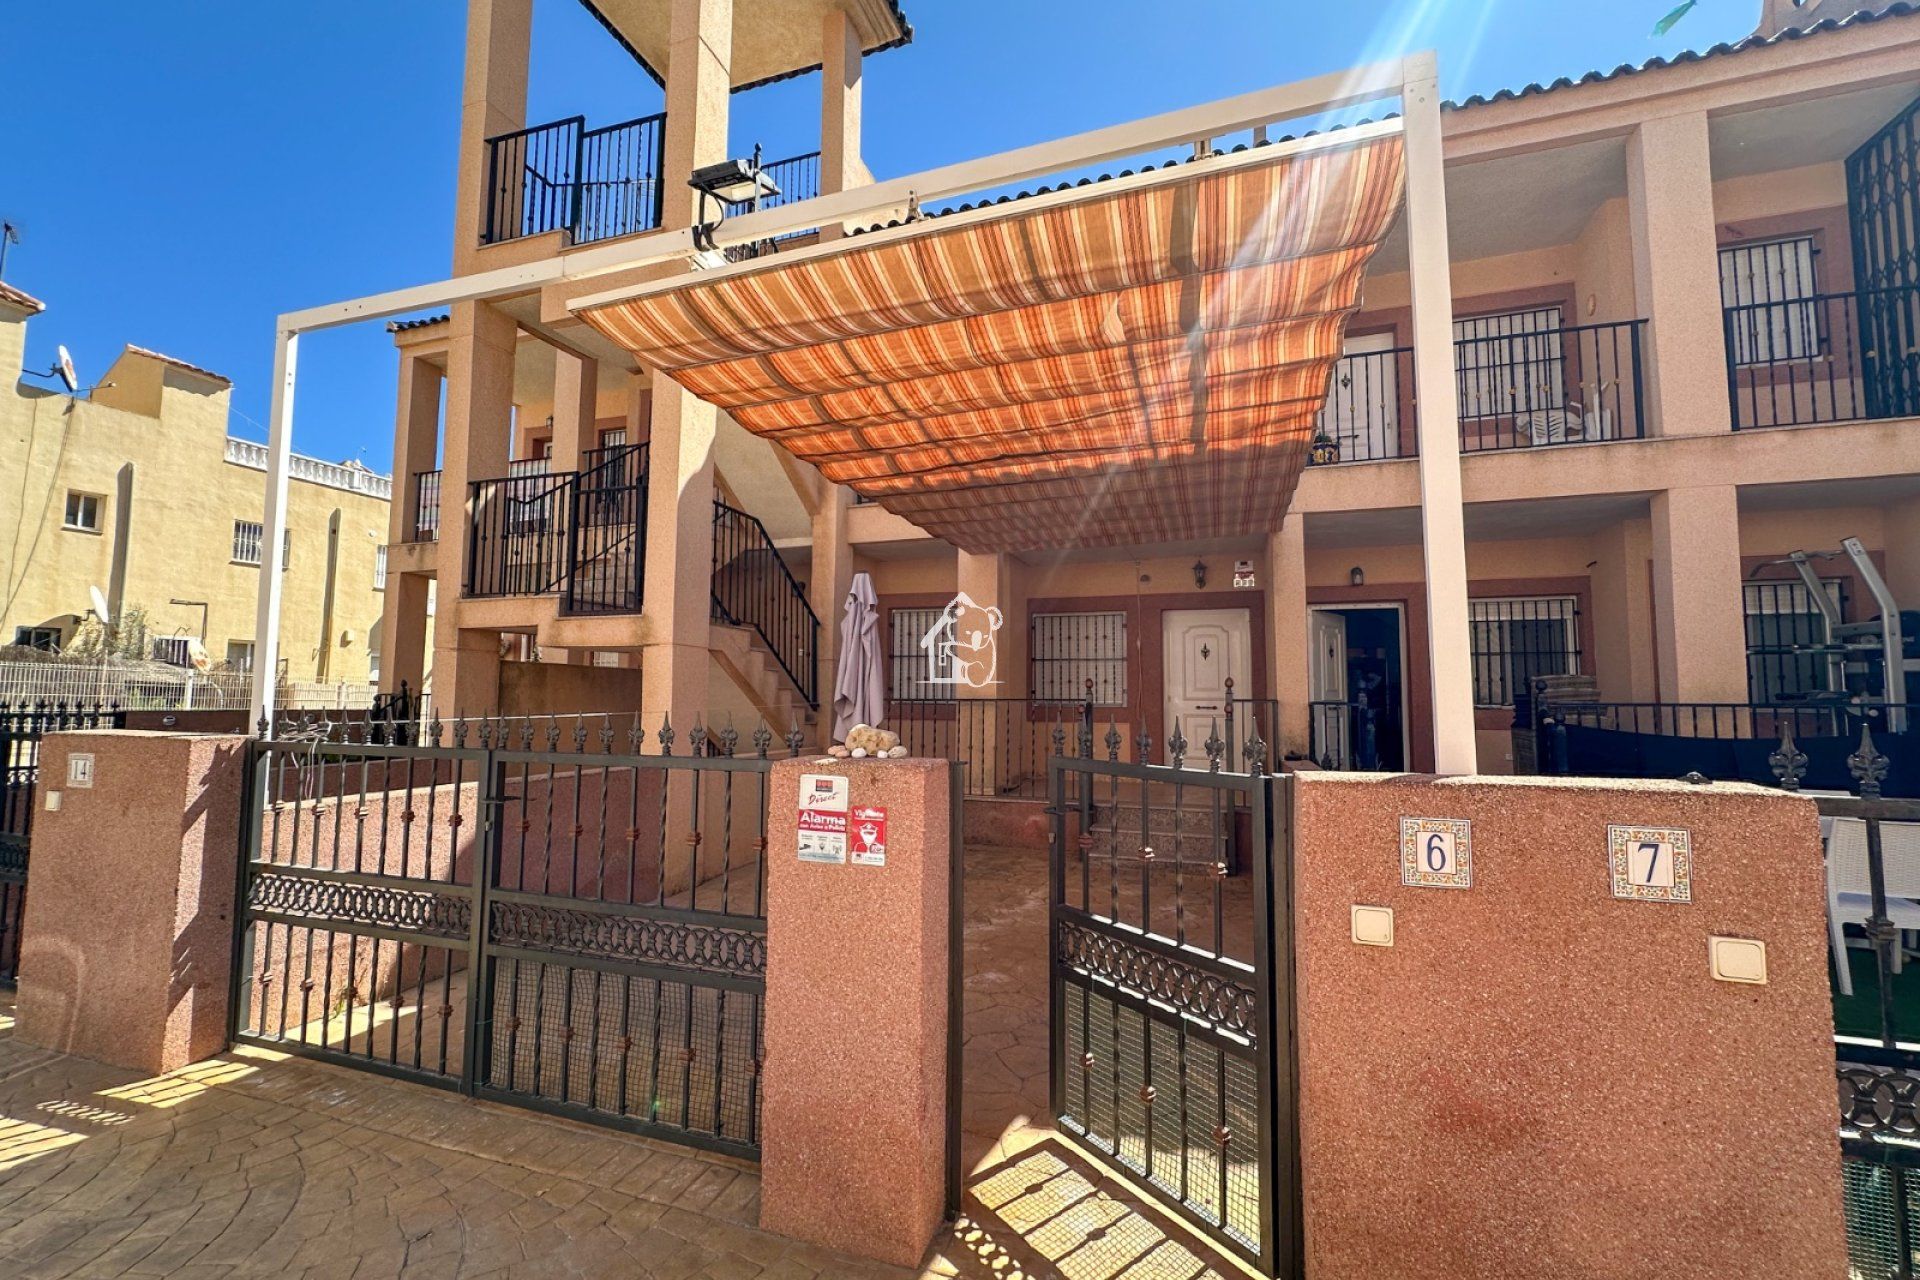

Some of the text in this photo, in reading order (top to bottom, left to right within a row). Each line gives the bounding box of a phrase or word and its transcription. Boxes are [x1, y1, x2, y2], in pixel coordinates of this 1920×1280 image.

[74, 761, 87, 779] 14
[800, 810, 846, 826] Alarma
[1426, 833, 1447, 872] 6
[1637, 843, 1660, 883] 7
